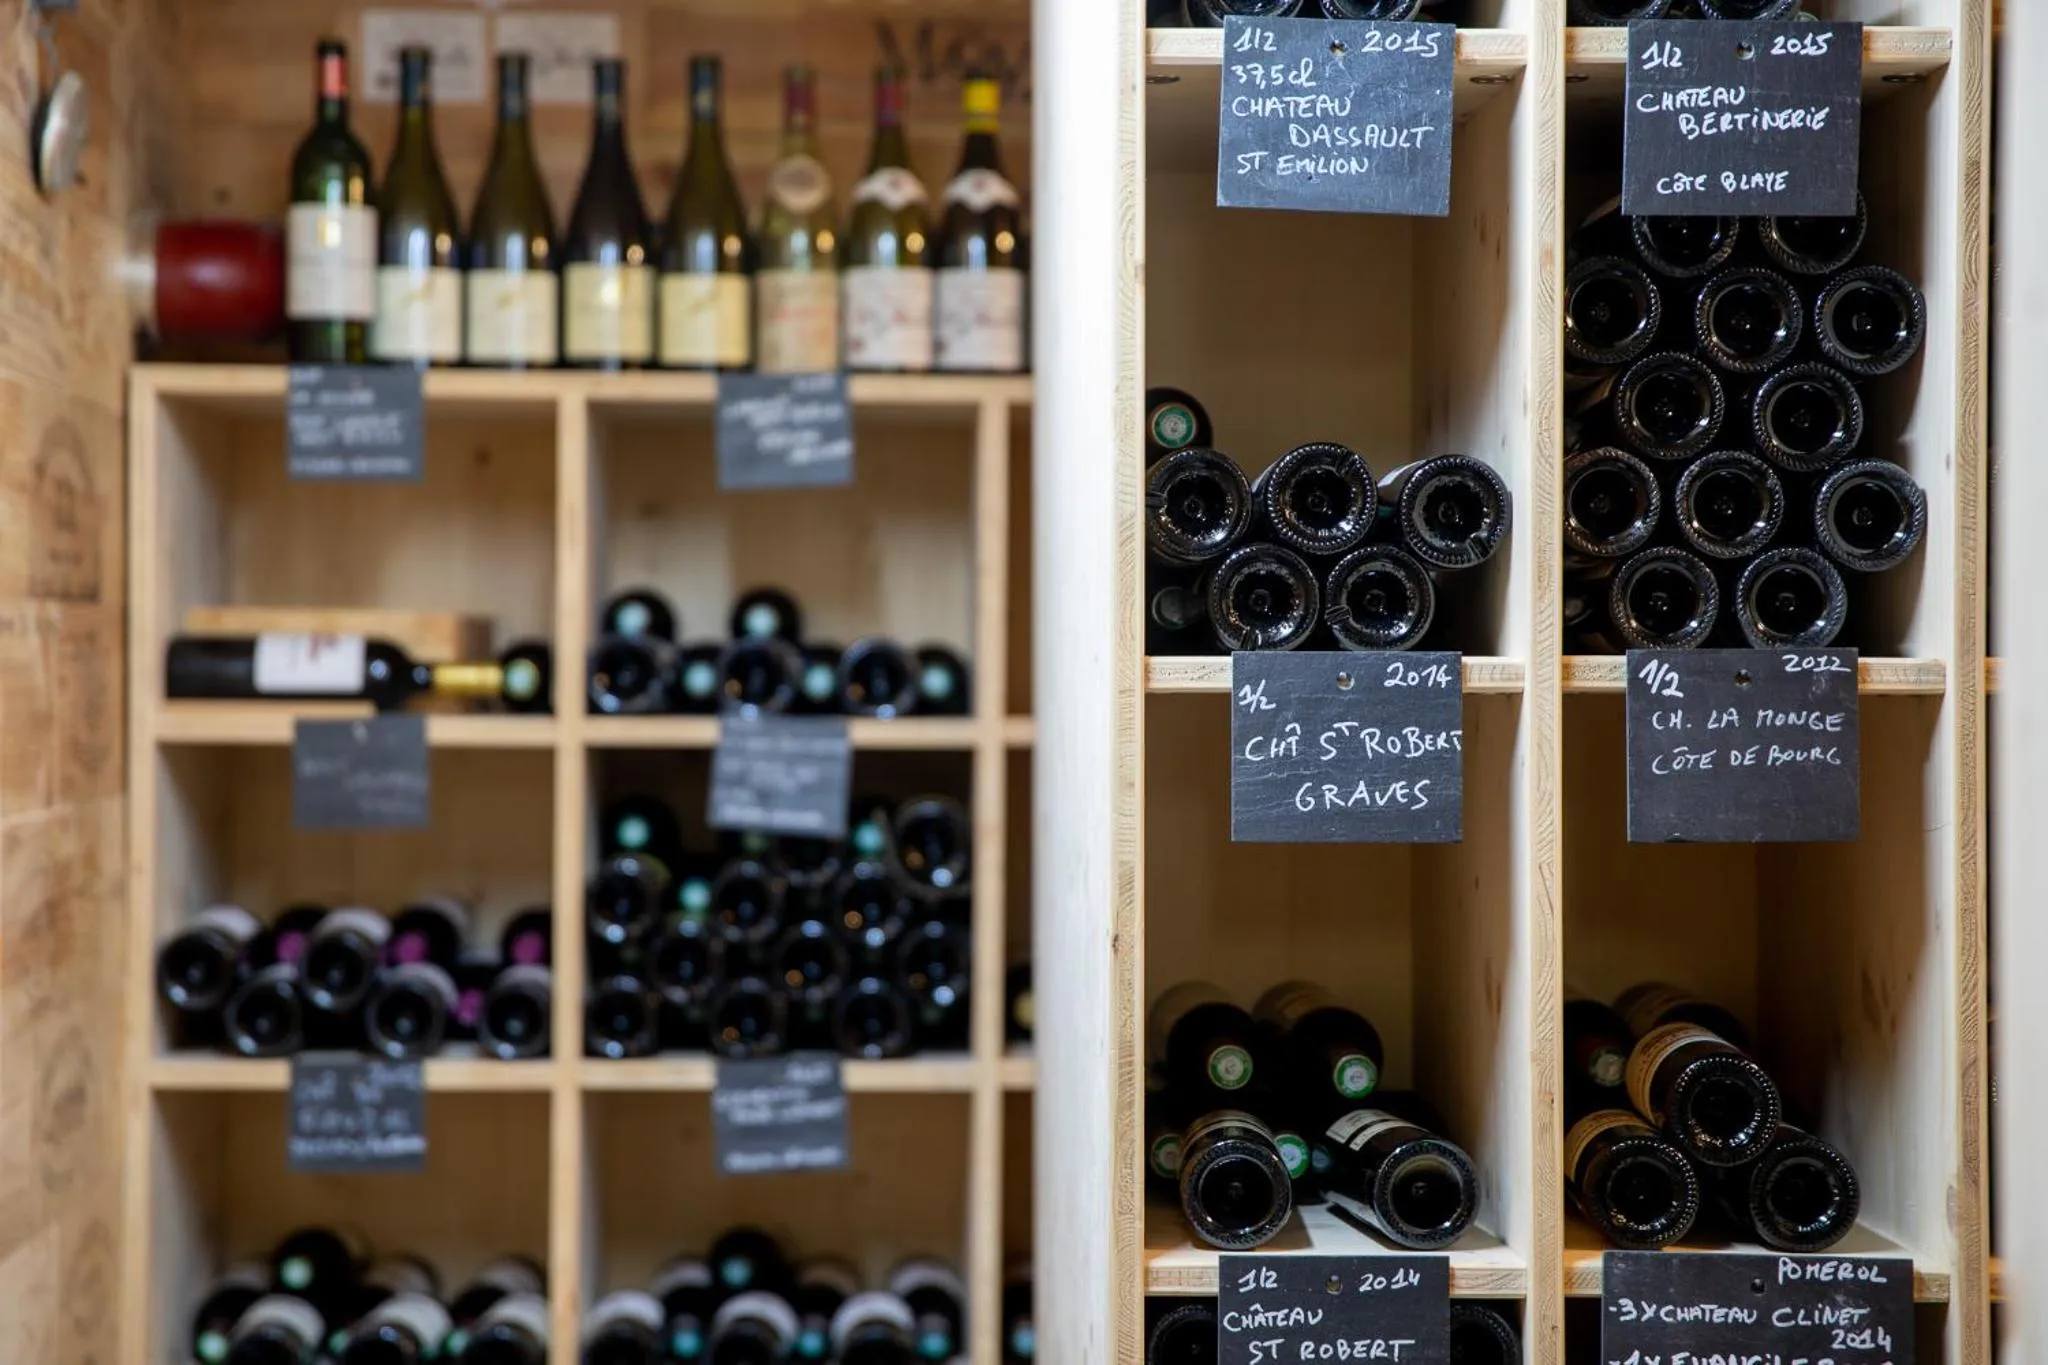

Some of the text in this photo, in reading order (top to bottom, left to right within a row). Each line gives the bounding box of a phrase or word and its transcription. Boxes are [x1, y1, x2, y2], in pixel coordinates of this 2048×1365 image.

[1361, 30, 1442, 57] 2015
[1641, 32, 1833, 71] 1/2 2015
[1232, 95, 1351, 118] CHATEAU
[1636, 85, 1746, 113] CHATEAU
[1289, 123, 1435, 149] DASSAULT
[1678, 106, 1830, 140] BERTINERIE
[1237, 151, 1270, 175] ST
[1720, 170, 1790, 193] BLAYE
[1238, 662, 1452, 713] 1/2 2014
[1638, 654, 1851, 698] 1/2 2012
[1652, 707, 1845, 732] CH. LA MONGE
[1360, 726, 1463, 760] ROBERT
[1652, 745, 1842, 775] CÔTE DE BOURG
[1295, 779, 1431, 811] GRAVES
[1238, 1266, 1421, 1293] 1/2 2014
[1778, 1257, 1887, 1285] POMEROL
[1222, 1303, 1323, 1332] CHÂTEAU
[1771, 1303, 1871, 1328] CLINET
[1249, 1338, 1416, 1365] ST ROBERT
[1831, 1326, 1892, 1352] 2014
